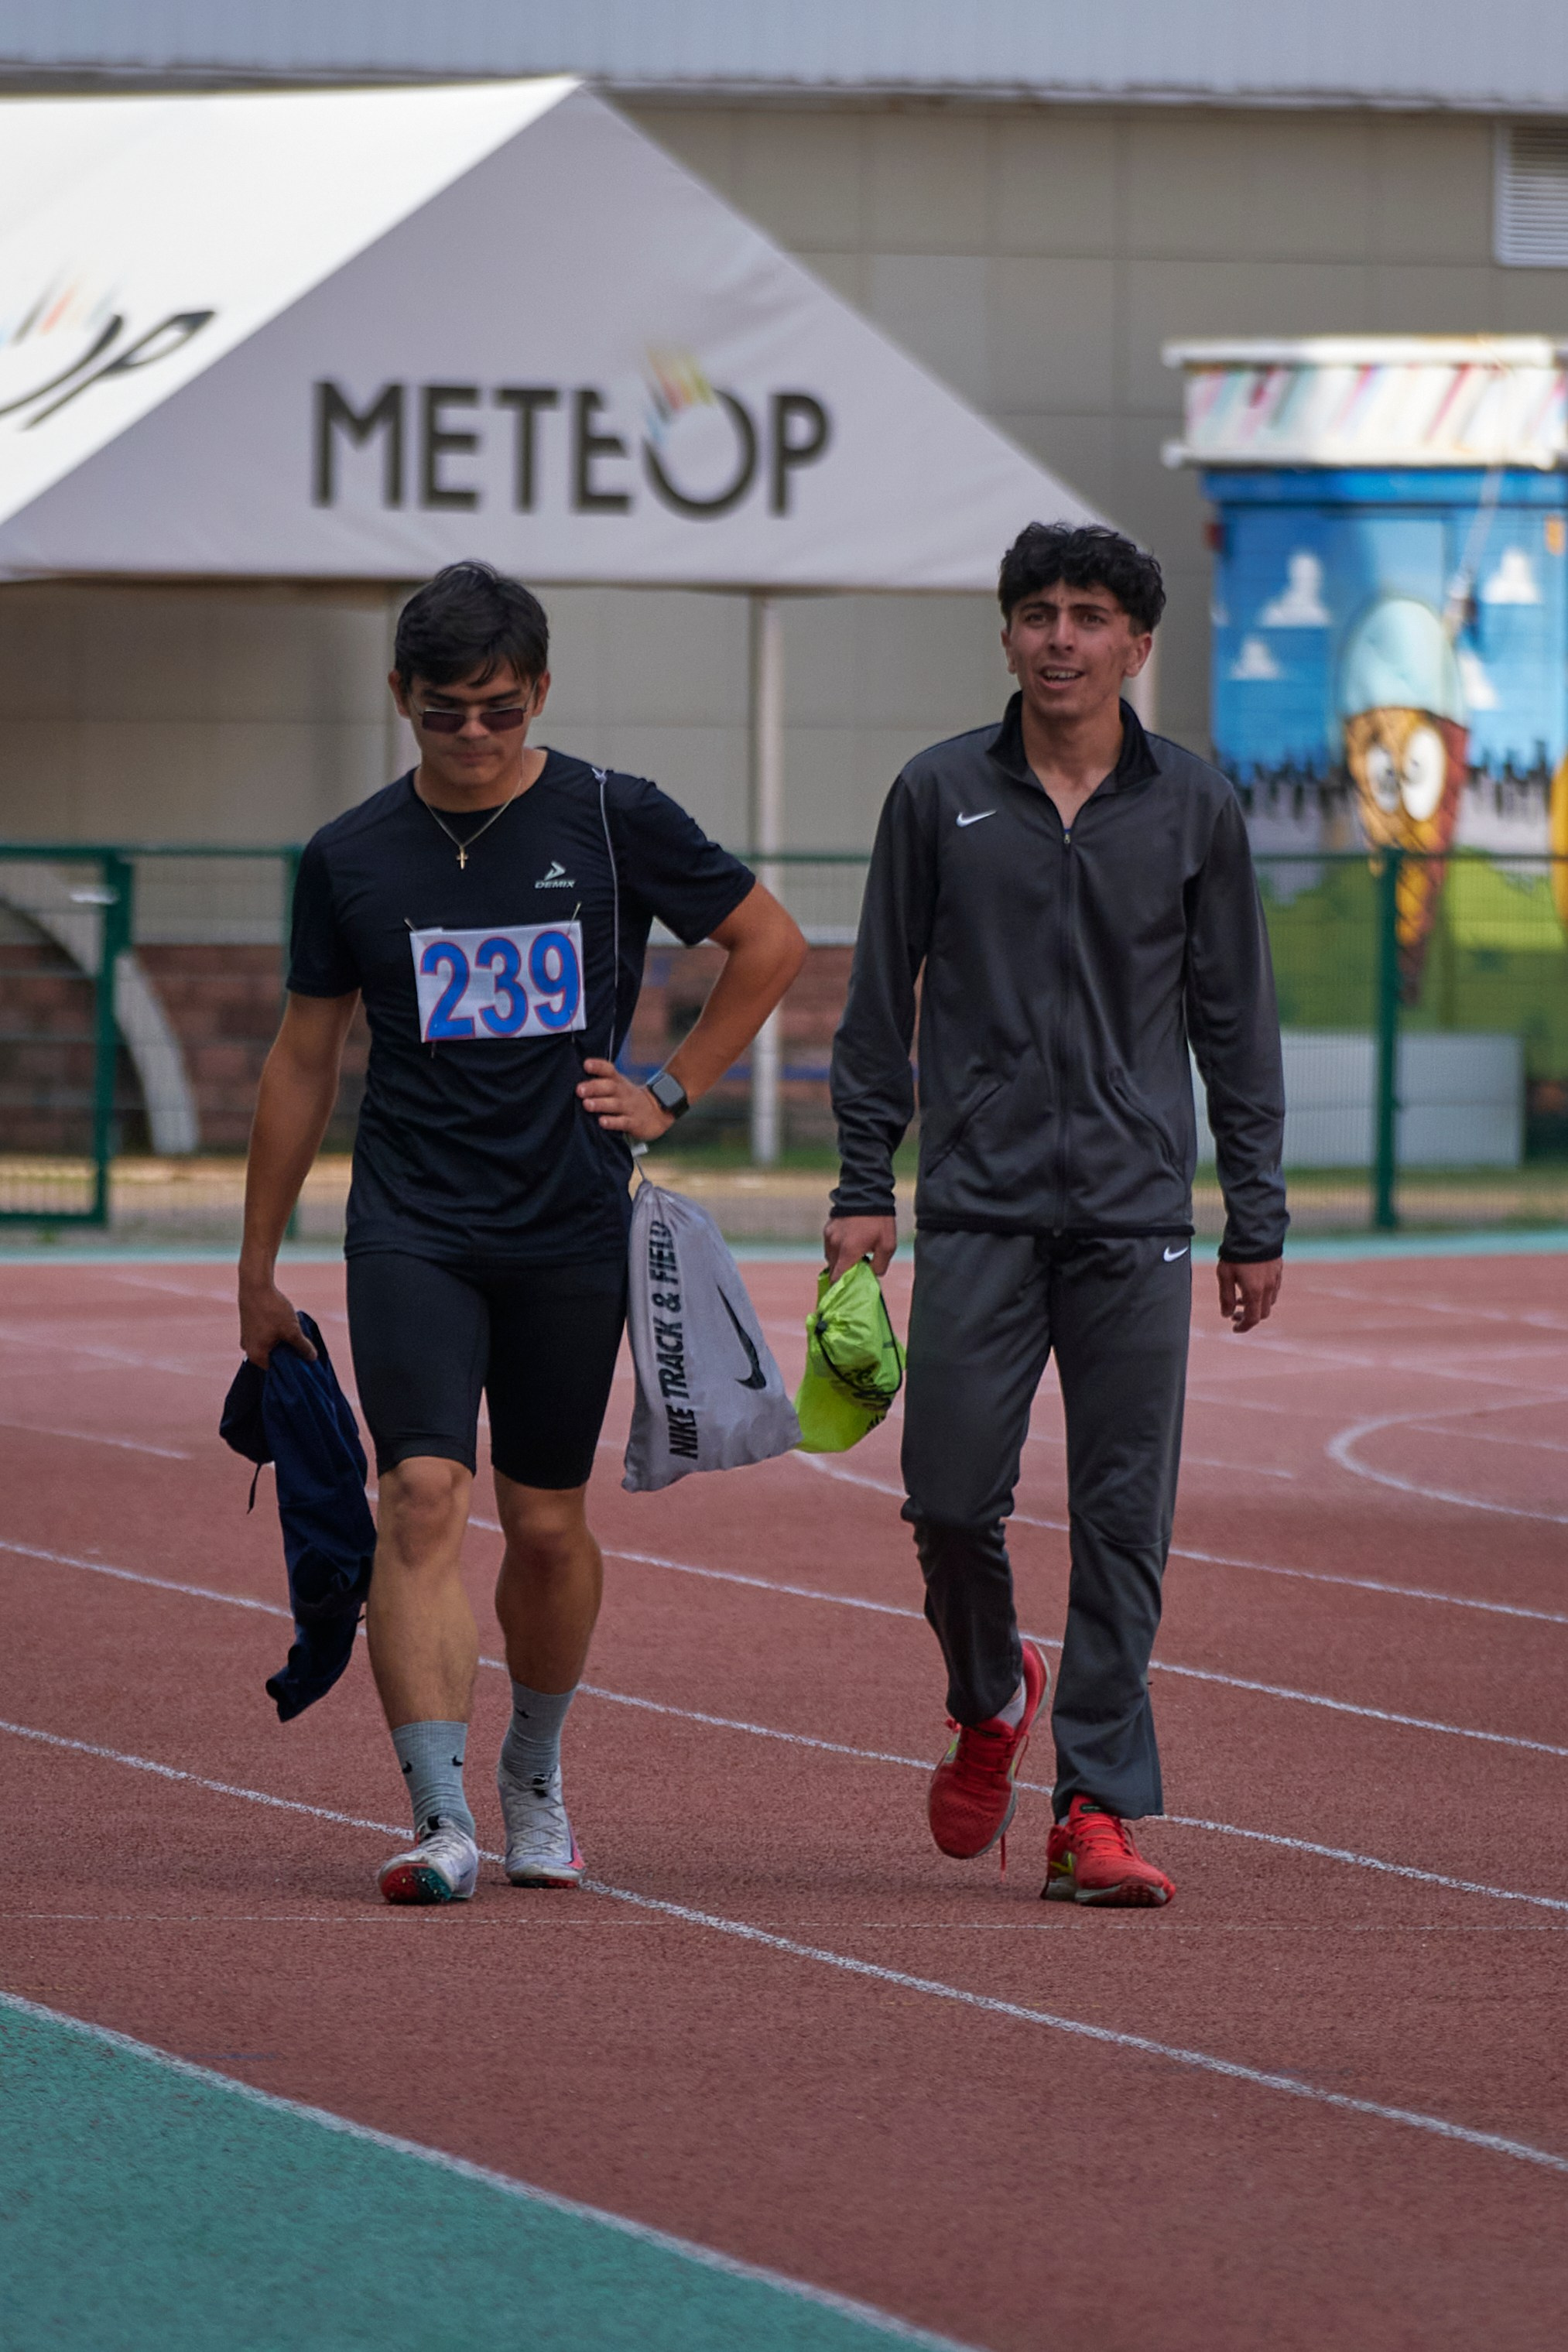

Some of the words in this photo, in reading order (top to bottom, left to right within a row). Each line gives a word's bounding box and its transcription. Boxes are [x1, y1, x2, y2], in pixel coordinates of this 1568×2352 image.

[313, 382, 830, 523] МЕТЕОР
[534, 879, 576, 889] DEMIX
[420, 930, 580, 1042] 239
[648, 1220, 680, 1285] FIELD
[652, 1292, 681, 1313] &
[655, 1319, 691, 1399] TRACK
[666, 1405, 698, 1460] NIKE
